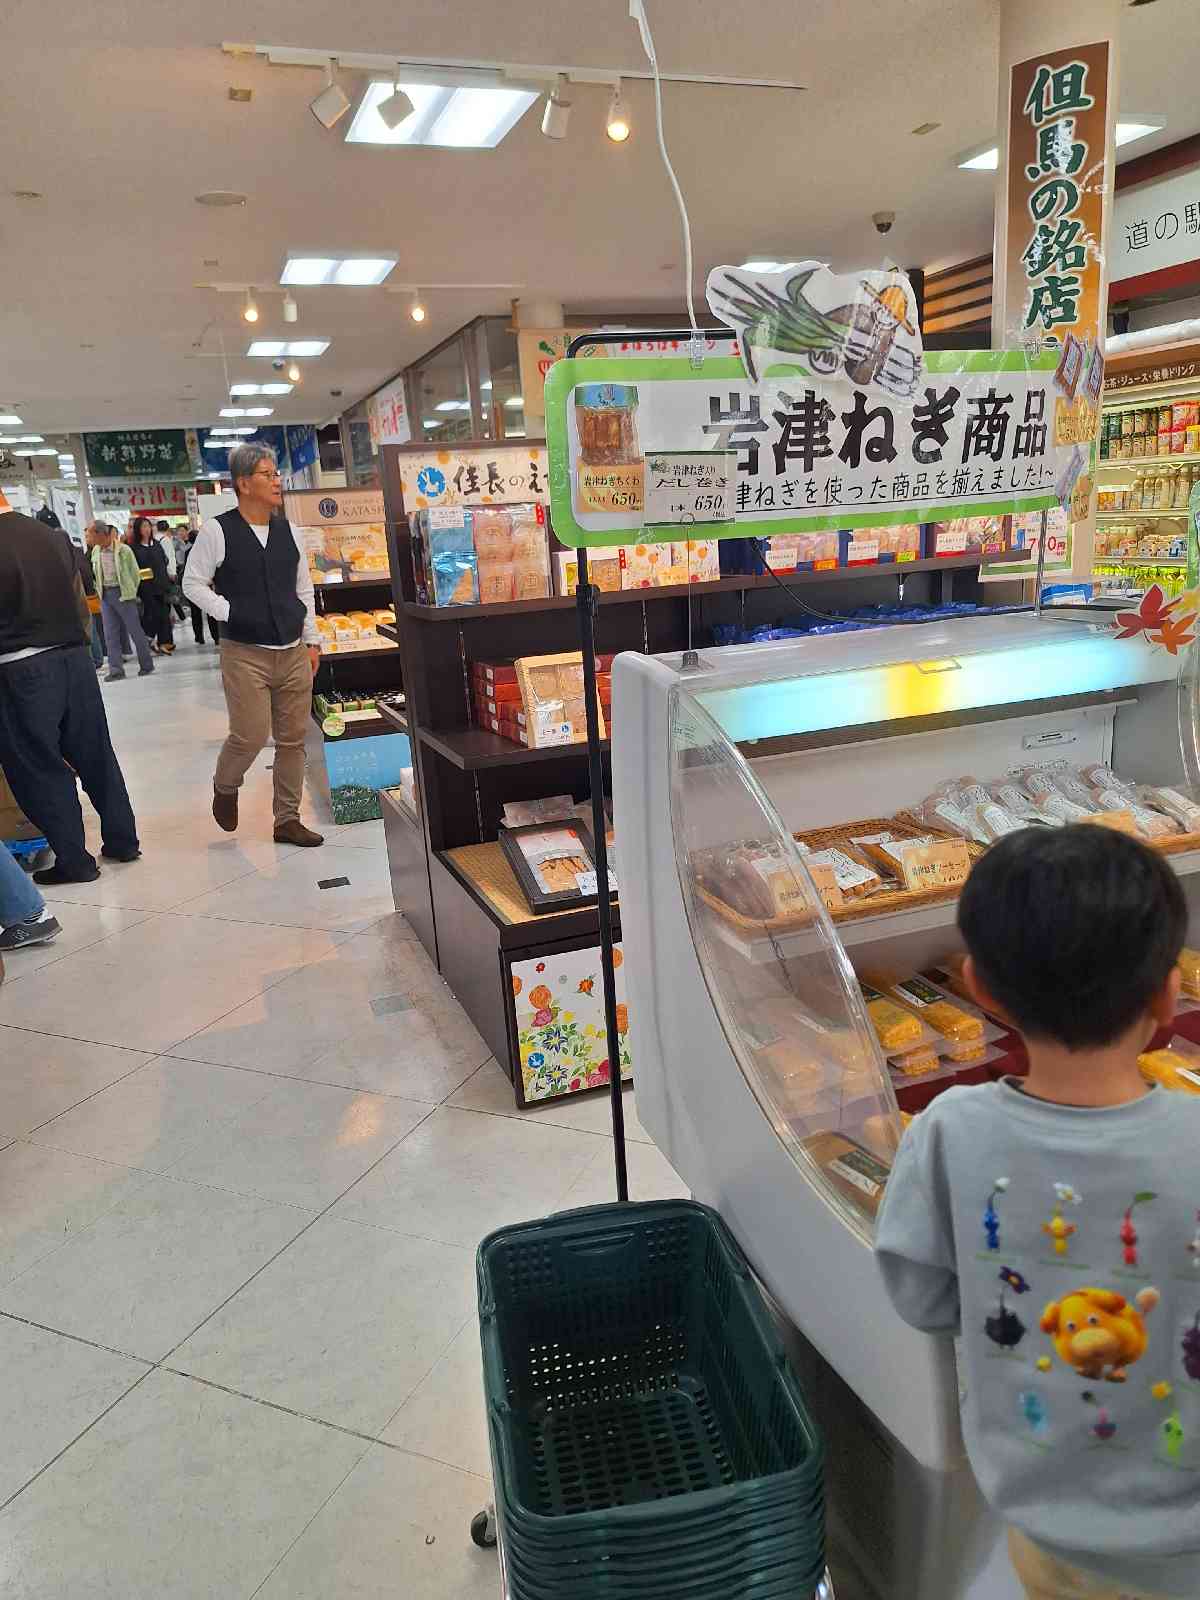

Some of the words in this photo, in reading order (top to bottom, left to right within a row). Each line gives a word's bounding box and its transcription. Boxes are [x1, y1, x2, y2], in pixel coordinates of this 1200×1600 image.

[1023, 61, 1094, 348] 但馬の銘店
[620, 340, 715, 352] まほろばキン
[703, 388, 1047, 475] 岩津ねぎ商品
[453, 461, 548, 496] 佳長のえ
[1028, 536, 1066, 551] 70円
